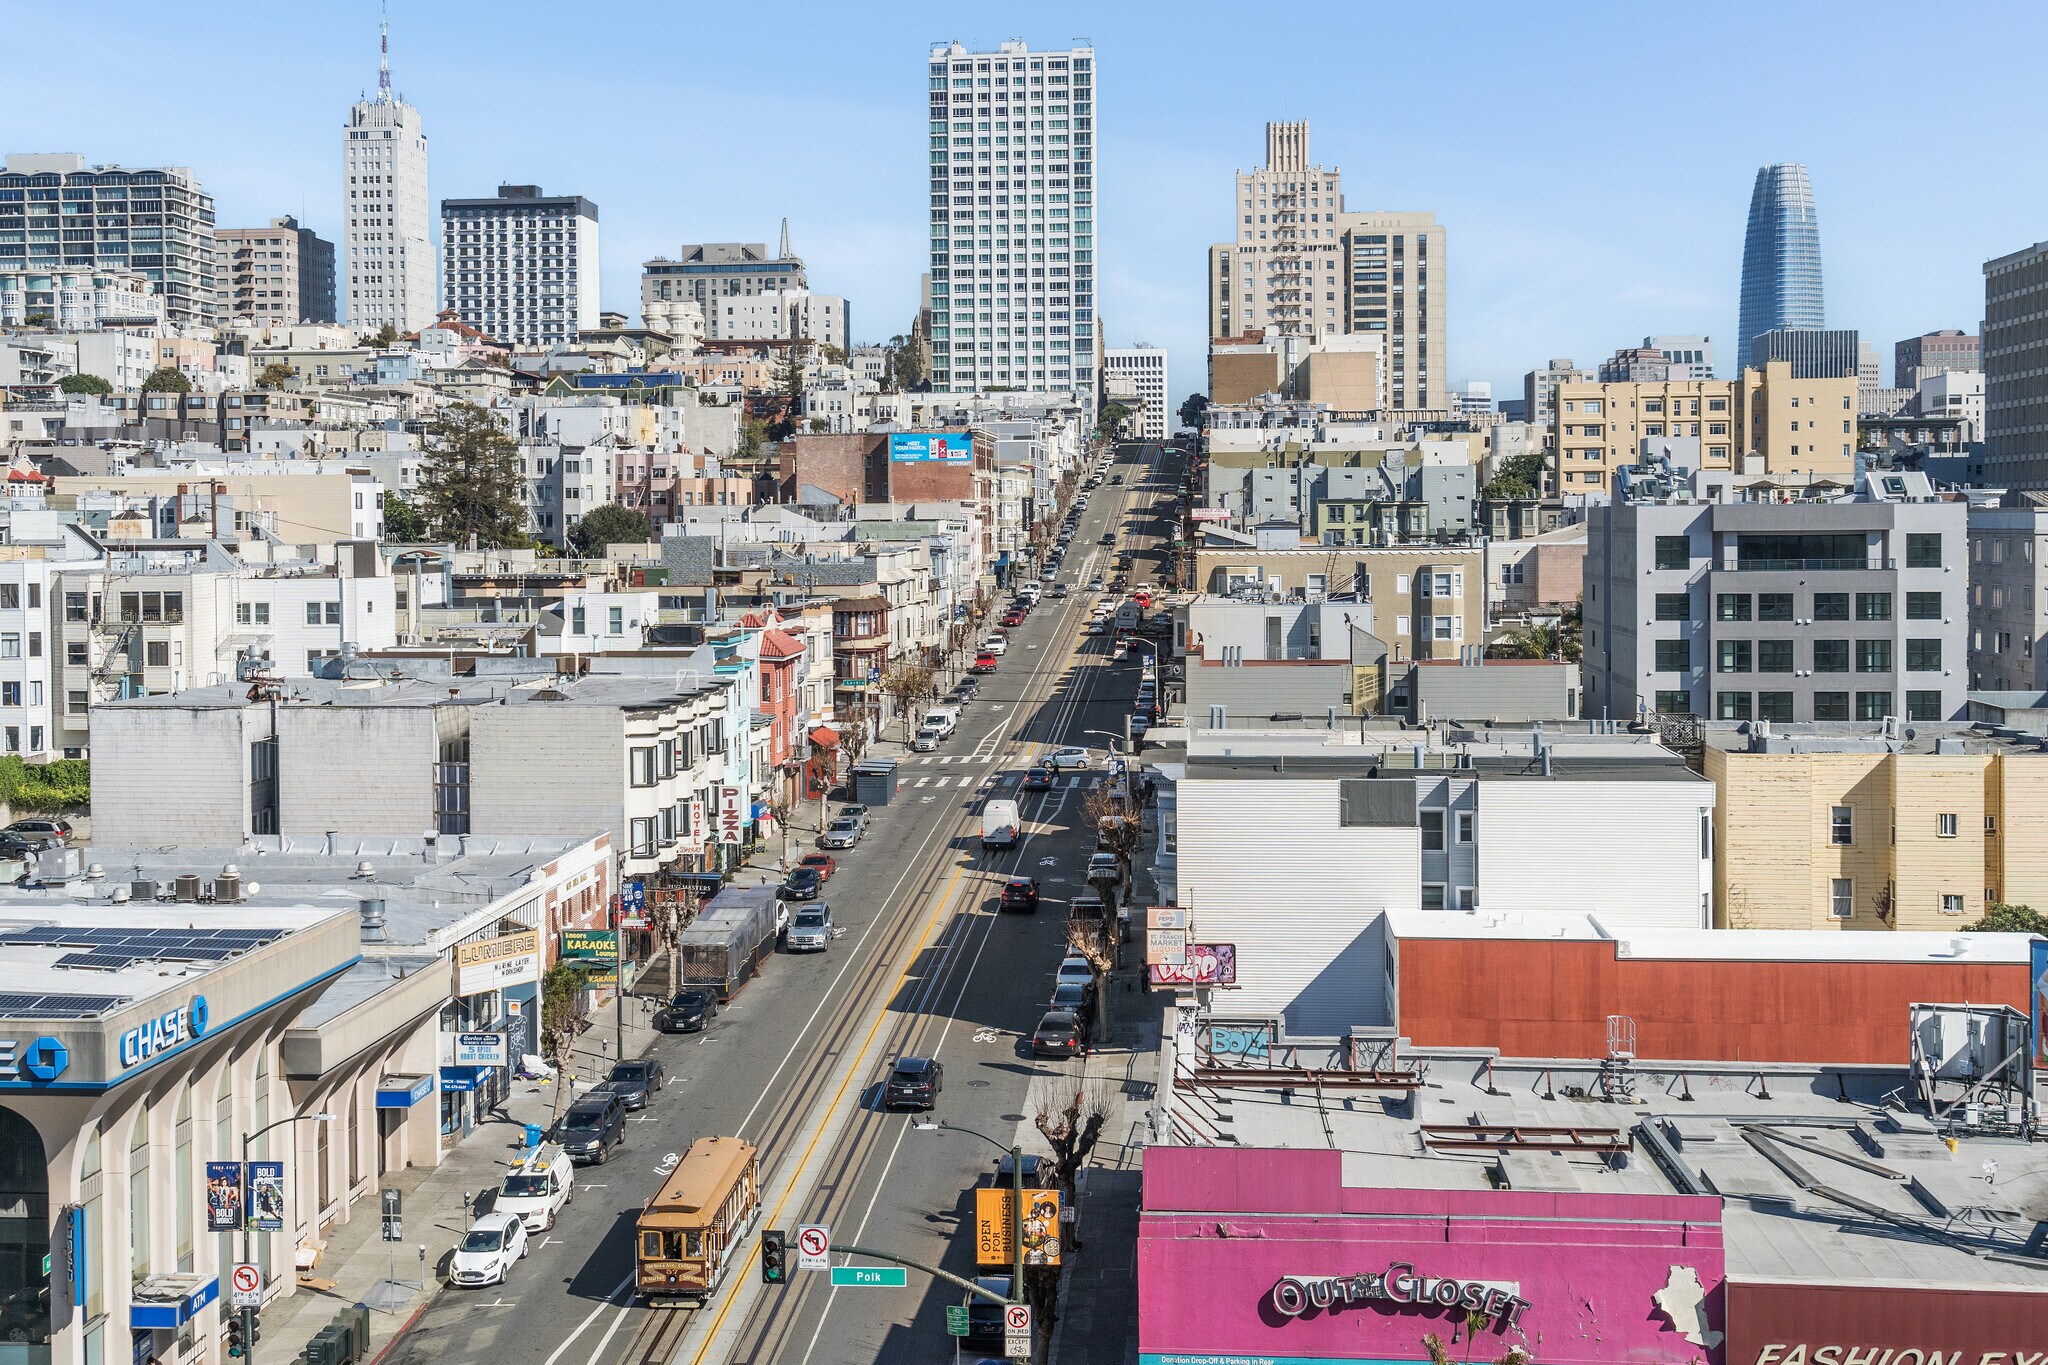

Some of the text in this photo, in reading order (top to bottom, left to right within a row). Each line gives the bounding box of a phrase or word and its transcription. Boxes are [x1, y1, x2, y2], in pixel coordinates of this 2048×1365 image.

[693, 803, 701, 845] HOTEL
[722, 788, 739, 841] PIZZA
[461, 935, 535, 964] LUMIERE
[567, 940, 616, 950] KARAOKE
[595, 950, 618, 958] Lounge
[120, 1006, 188, 1067] CHASE
[257, 1168, 275, 1177] BOLD
[215, 1208, 233, 1218] BOLD
[1002, 1195, 1012, 1252] BUSINESS
[981, 1219, 991, 1252] OPEN
[993, 1231, 1001, 1252] FOR
[856, 1271, 881, 1282] Polk
[192, 1290, 206, 1311] ATM
[1273, 1276, 1356, 1317] OUT
[1384, 1261, 1532, 1324] CLOSET
[1161, 1356, 1190, 1364] Donation
[1190, 1357, 1219, 1365] Drop-Off
[1225, 1357, 1251, 1365] Parking
